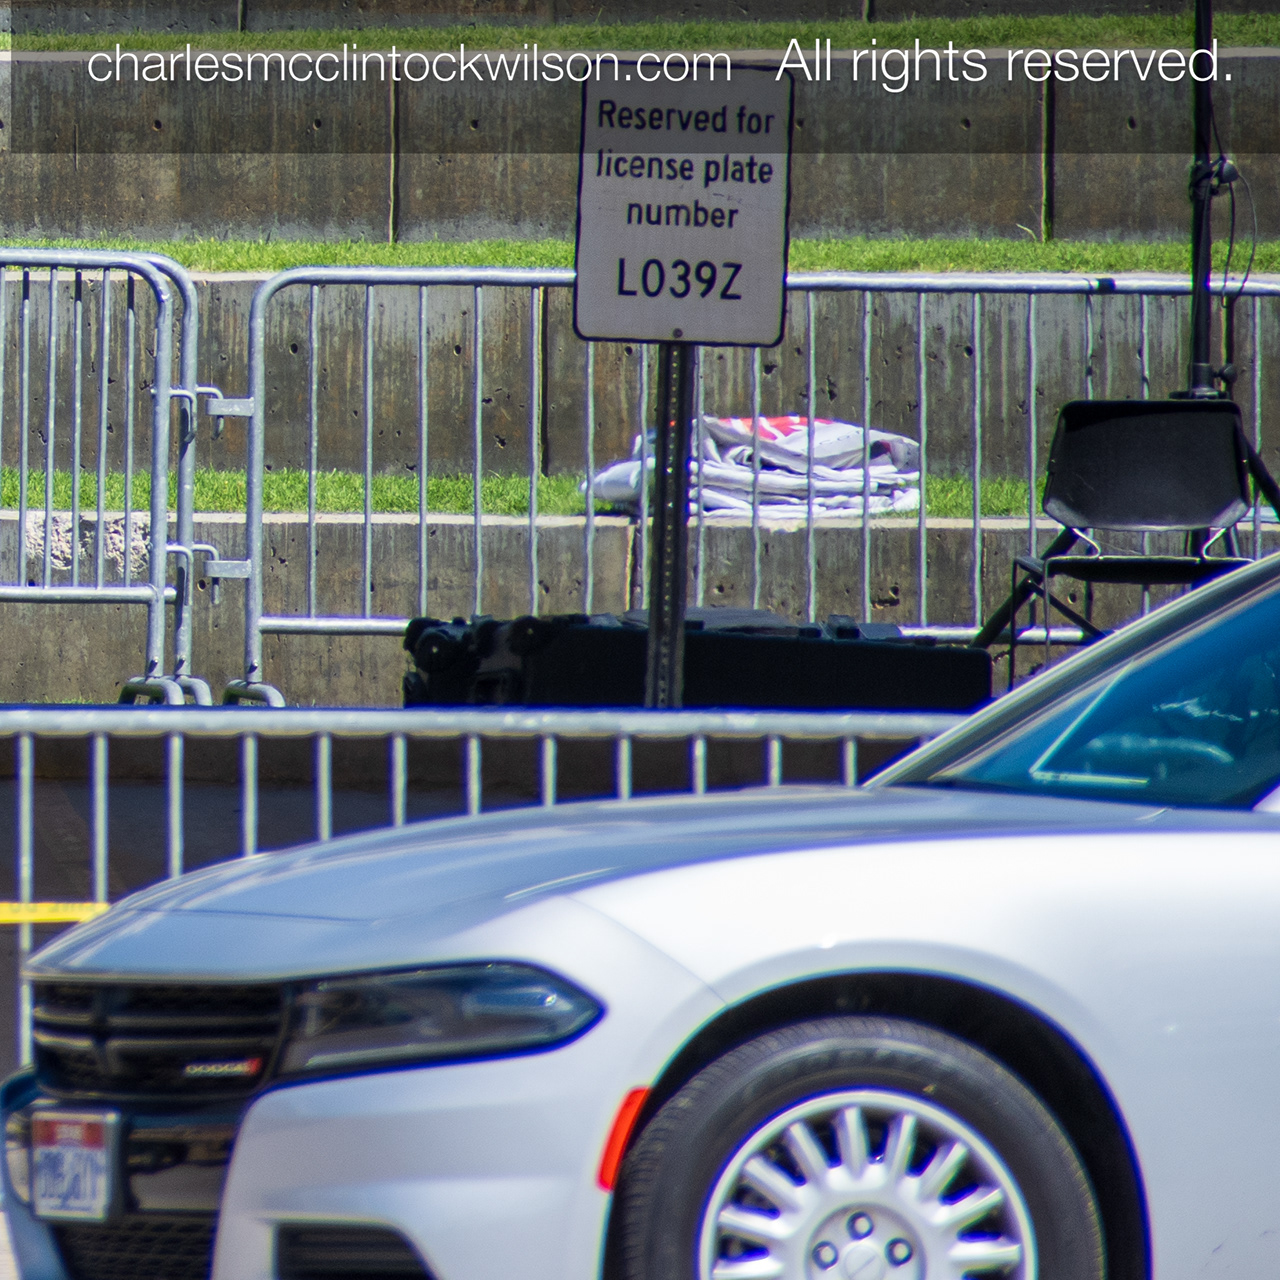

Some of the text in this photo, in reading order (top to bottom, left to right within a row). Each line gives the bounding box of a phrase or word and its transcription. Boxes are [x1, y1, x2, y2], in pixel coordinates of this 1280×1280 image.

[597, 99, 775, 134] Reserved for
[596, 149, 773, 188] license plate
[627, 200, 739, 229] number
